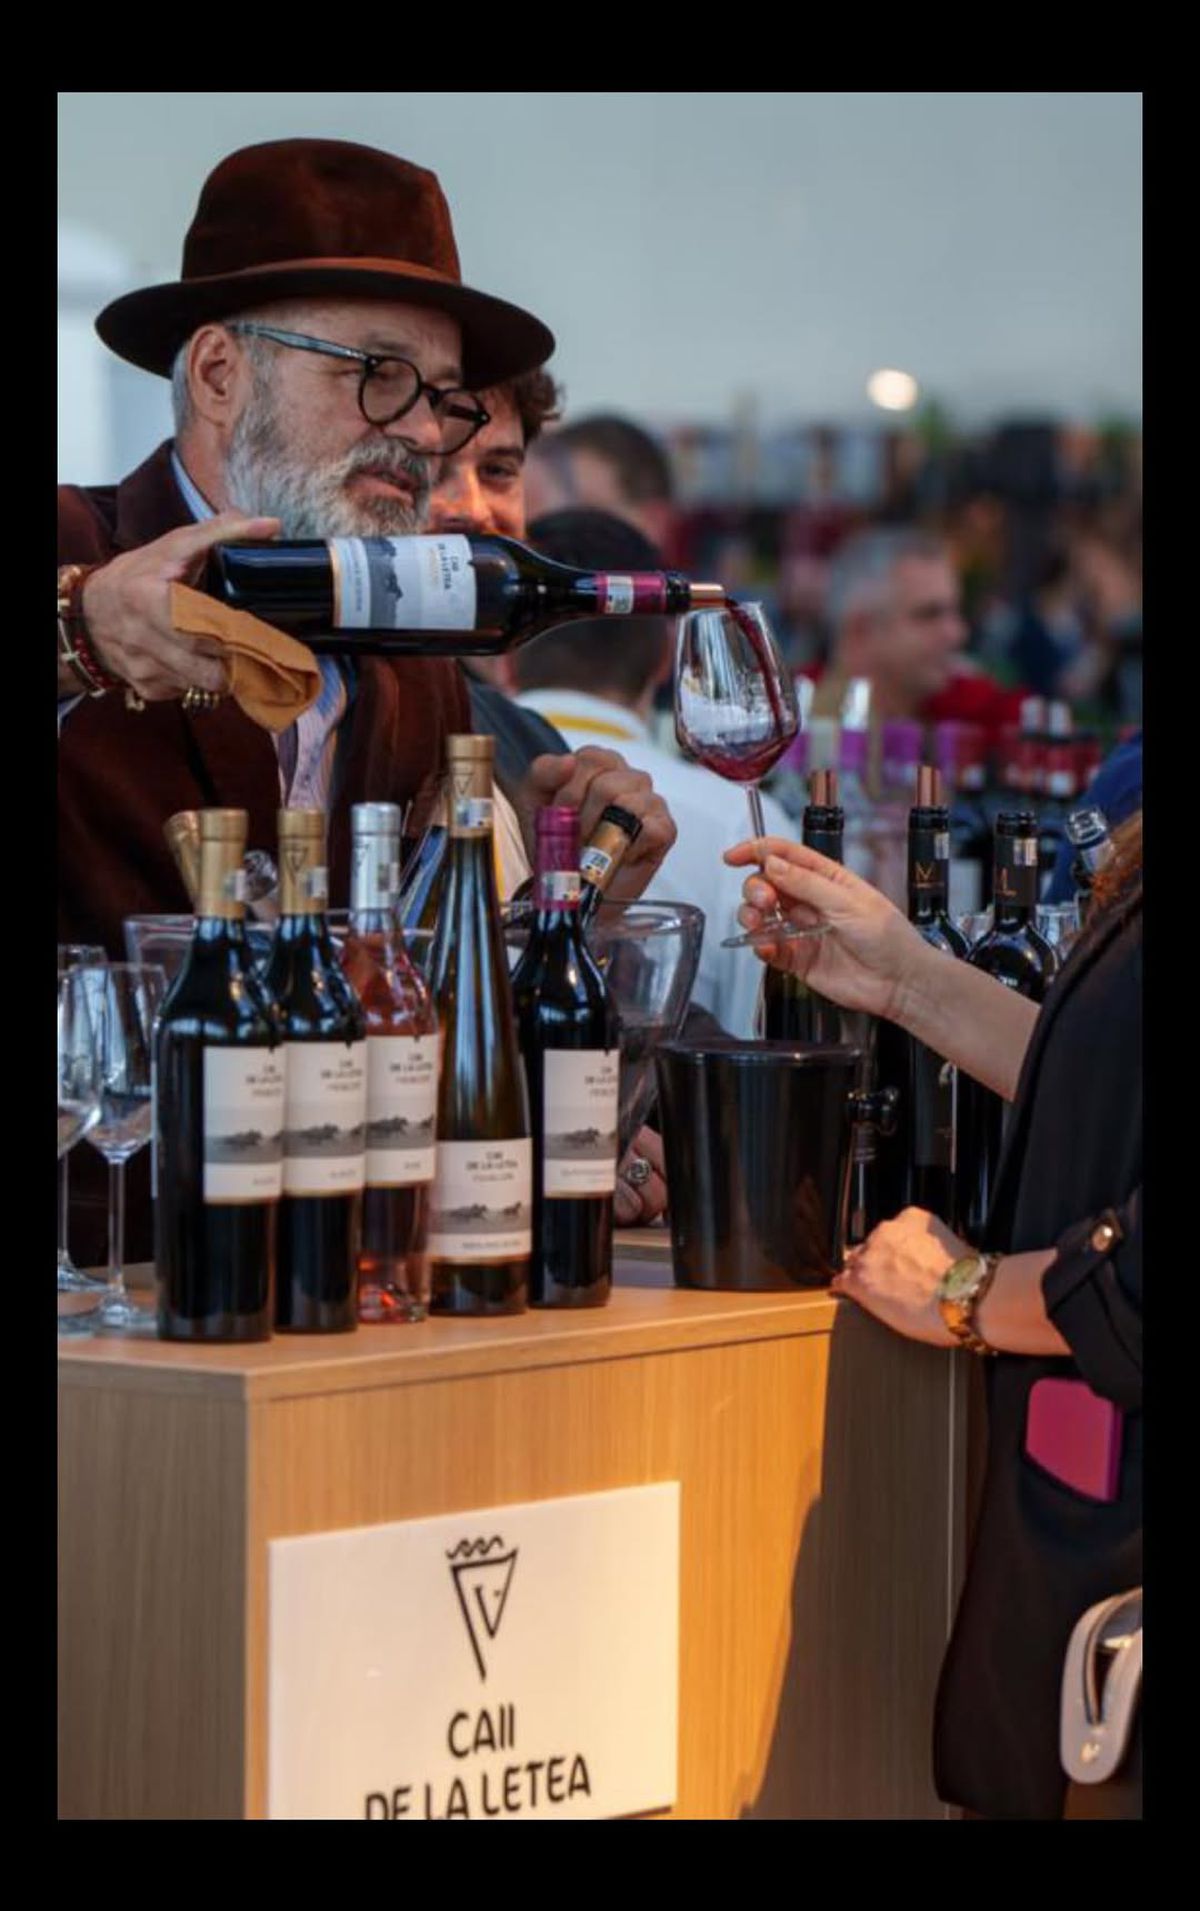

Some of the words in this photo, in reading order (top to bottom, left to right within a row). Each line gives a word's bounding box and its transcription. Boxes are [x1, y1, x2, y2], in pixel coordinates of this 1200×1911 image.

[447, 1703, 515, 1758] CAII
[365, 1784, 411, 1820] DE
[425, 1775, 469, 1820] LA
[481, 1753, 592, 1817] LETEA
